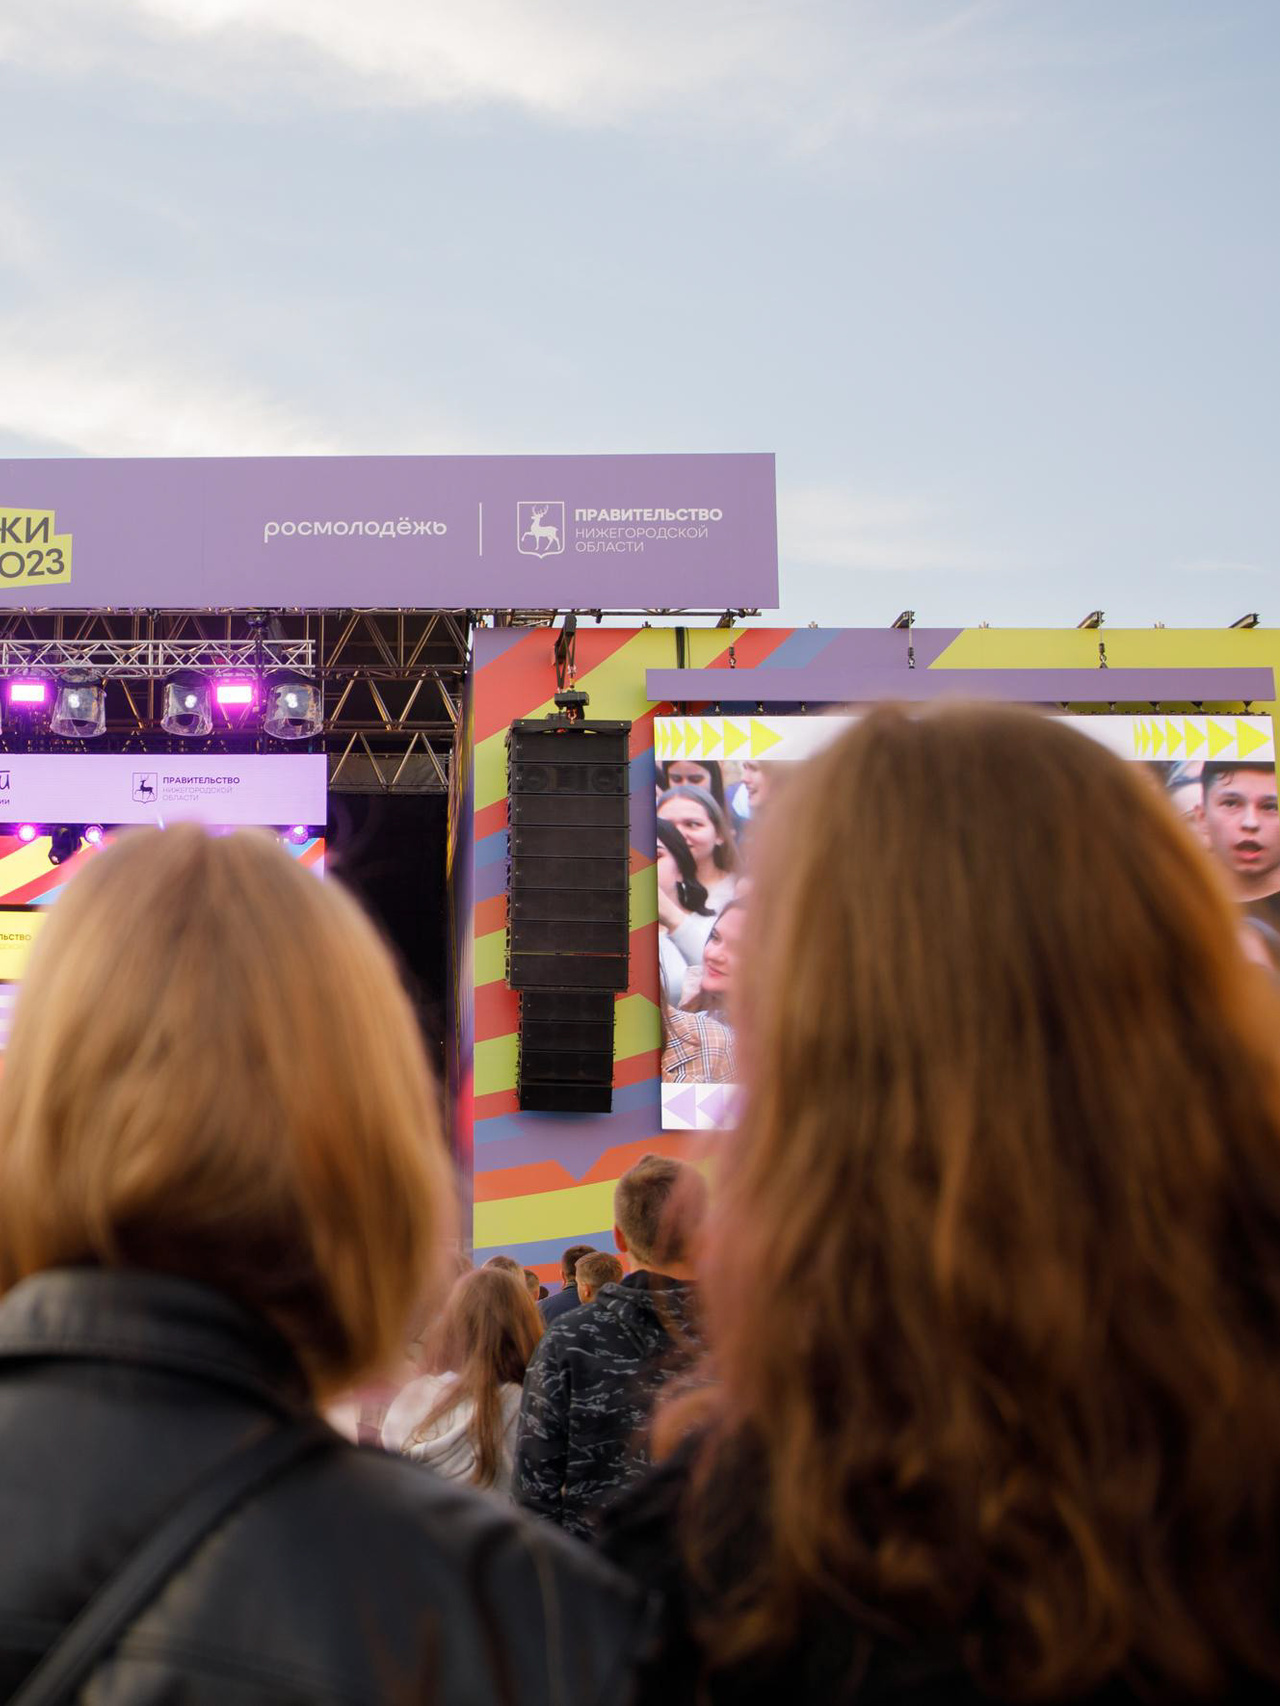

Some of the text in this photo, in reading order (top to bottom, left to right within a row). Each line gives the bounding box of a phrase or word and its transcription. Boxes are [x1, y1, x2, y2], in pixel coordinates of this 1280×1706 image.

[575, 508, 723, 521] ПРАВИТЕЛЬСТВО
[264, 517, 448, 544] росмолодёжь
[575, 524, 709, 540] НИЖЕГОРОДСКОЙ
[575, 541, 645, 553] ОБЛАСТИ
[162, 776, 241, 784] ПРАВИТЕЛЬСТВО
